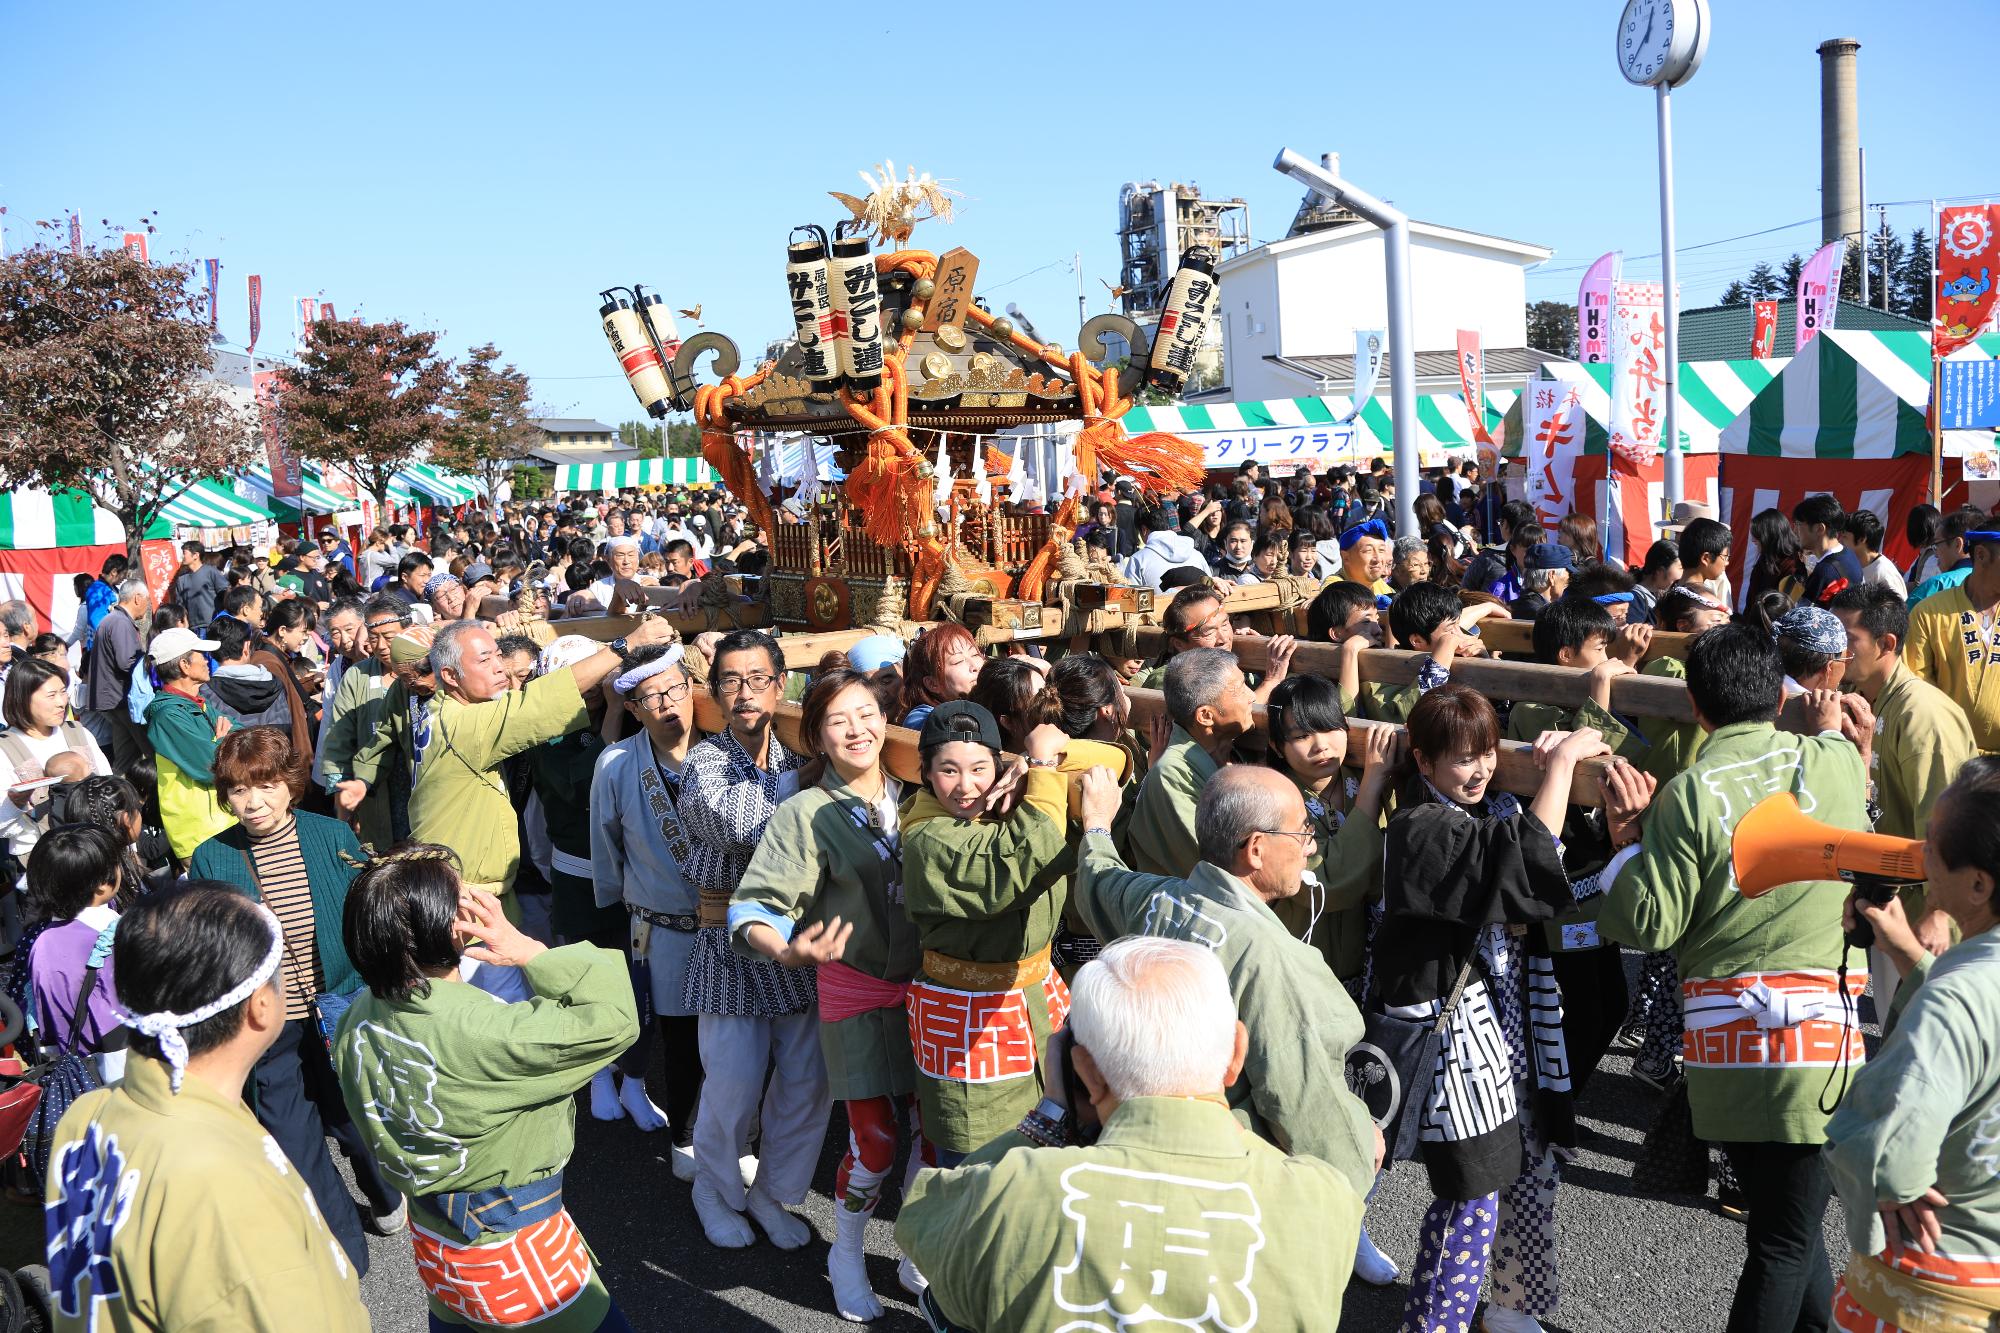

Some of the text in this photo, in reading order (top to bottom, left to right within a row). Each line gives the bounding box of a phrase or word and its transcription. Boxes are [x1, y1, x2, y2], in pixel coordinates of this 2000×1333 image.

[1634, 5, 1642, 17] 11
[1663, 3, 1670, 14] 2
[1627, 22, 1636, 34] 10
[1665, 20, 1673, 31] 3
[1625, 38, 1633, 48] 9
[1662, 37, 1671, 48] 4
[1656, 54, 1664, 65] 5
[1635, 63, 1642, 74] 7
[1645, 64, 1653, 75] 6
[814, 268, 831, 310] 原宿区
[940, 266, 967, 323] 原宿
[1203, 432, 1355, 458] タリークラブ
[1960, 611, 1982, 665] 小江戸
[1988, 617, 2000, 665] 江戸
